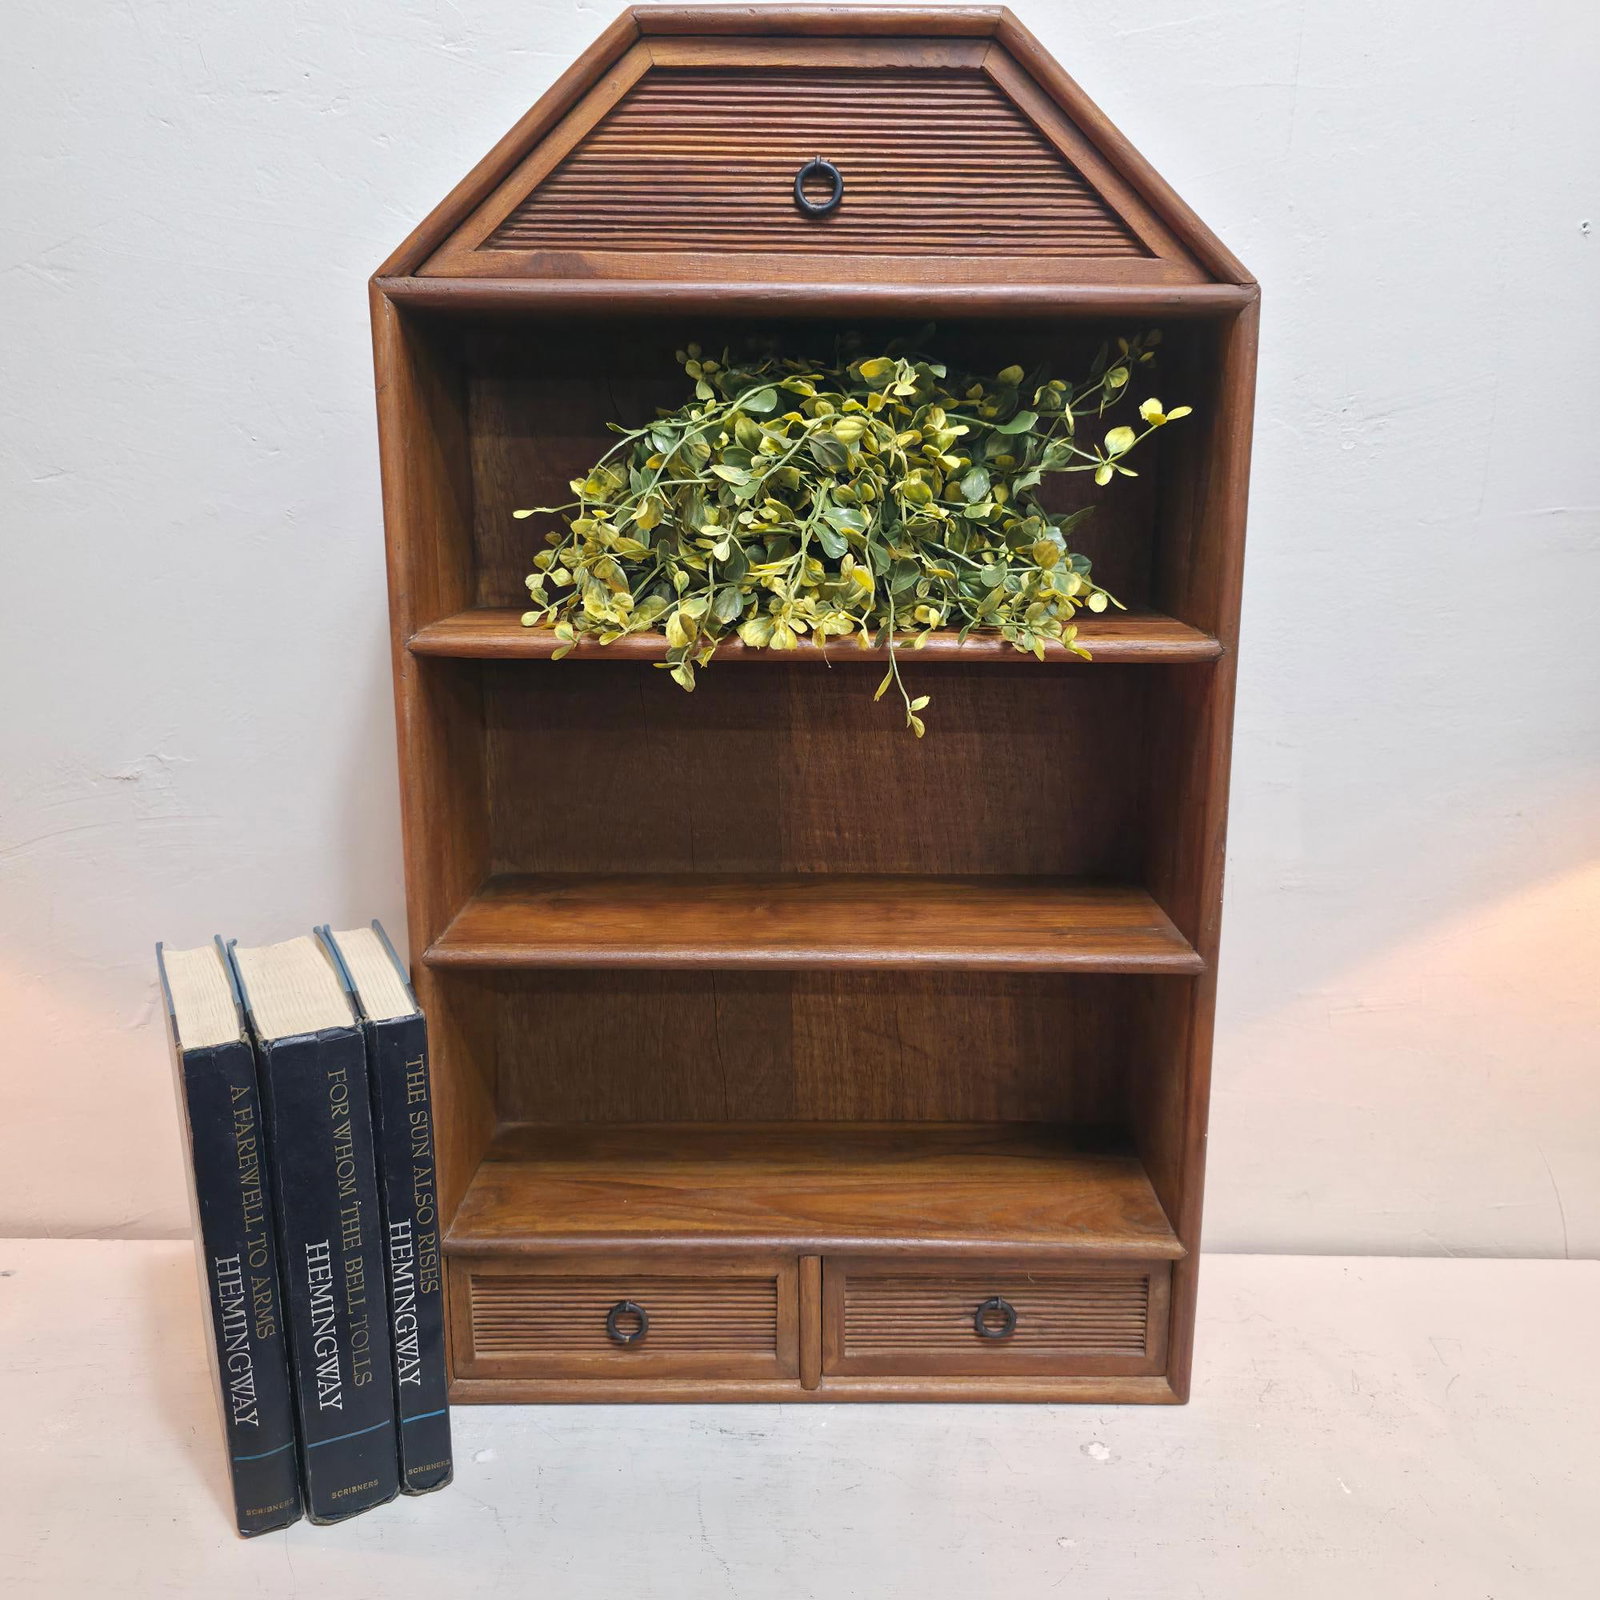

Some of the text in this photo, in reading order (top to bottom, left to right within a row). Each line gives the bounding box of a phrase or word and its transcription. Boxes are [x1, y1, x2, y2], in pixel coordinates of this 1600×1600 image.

[230, 1084, 277, 1340] A FAREWELL TO ARMS
[327, 1067, 373, 1387] FOR WHOM THE BELL TOLLS
[405, 1053, 440, 1294] THE SUN ALSO RISES
[214, 1252, 260, 1427] HEMINGWAY
[305, 1238, 343, 1411] HEMINGWAY
[388, 1217, 422, 1387] HEMINGWAY
[245, 1496, 295, 1517] SCRIBNERS
[330, 1478, 380, 1500] SCRIBNERS
